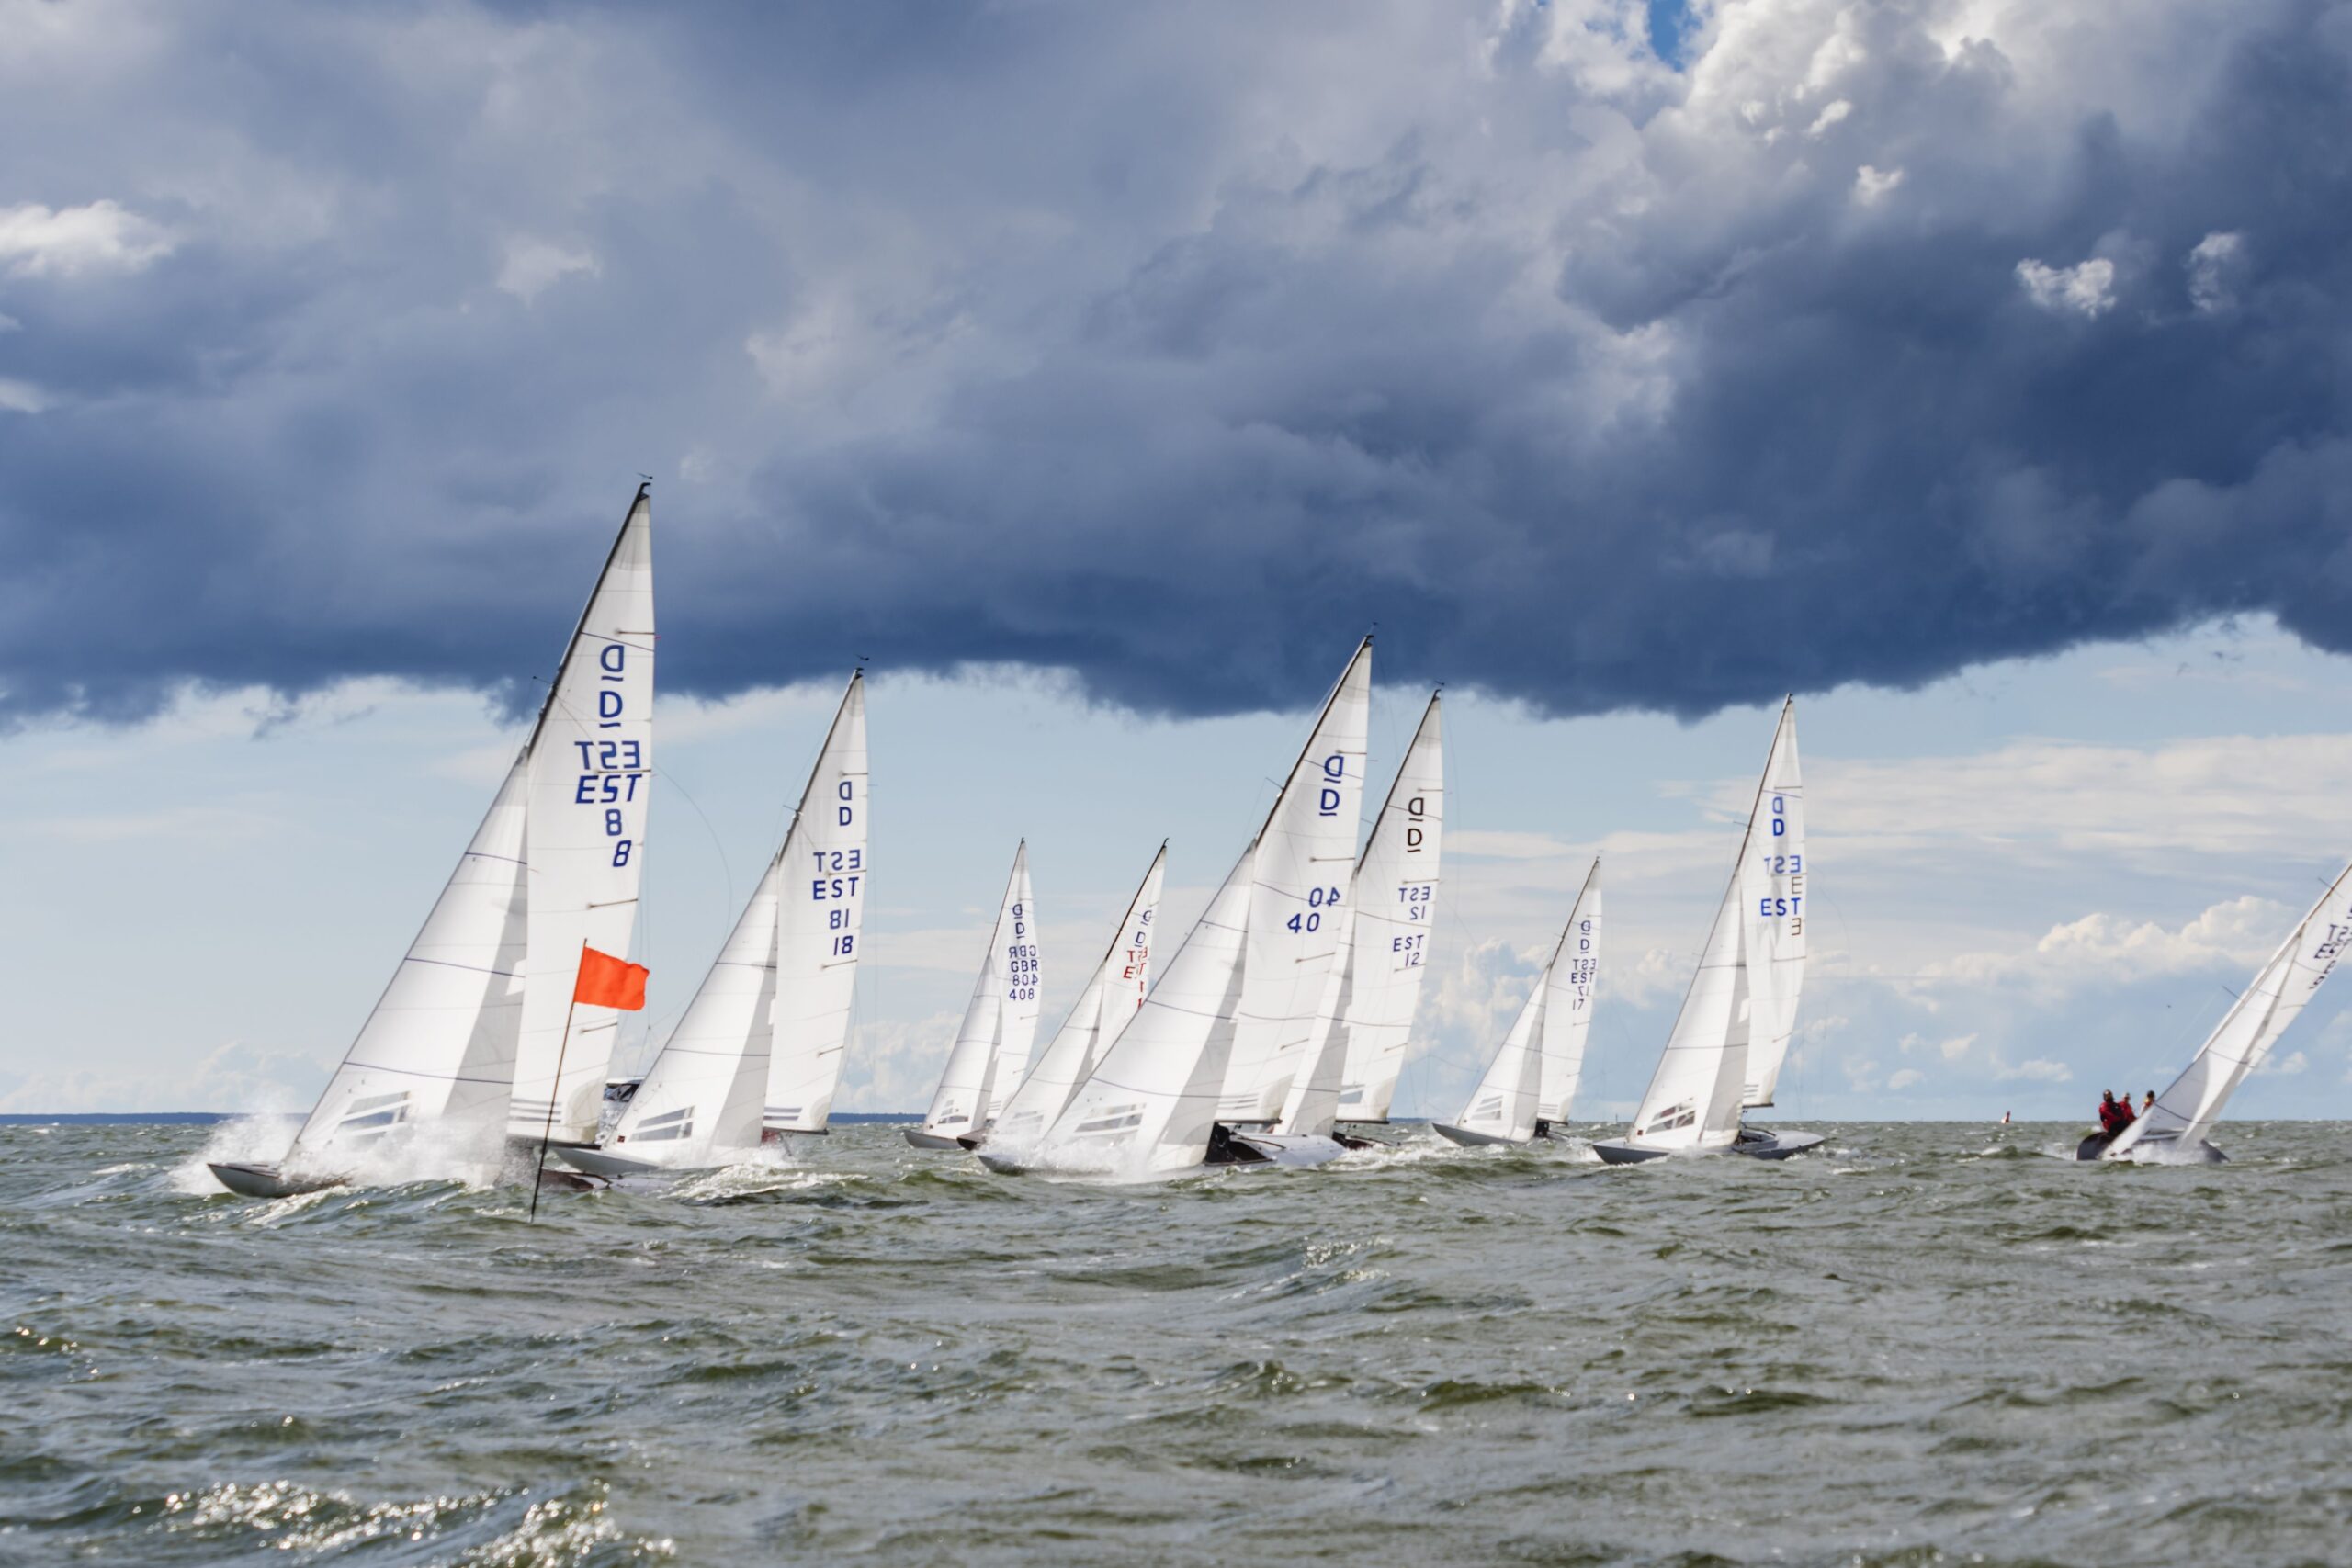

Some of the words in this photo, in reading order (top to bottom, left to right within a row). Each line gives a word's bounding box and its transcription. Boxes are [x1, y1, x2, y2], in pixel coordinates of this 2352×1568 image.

[599, 691, 623, 718] D
[575, 773, 643, 804] EST
[1321, 788, 1340, 811] D
[839, 807, 852, 826] D
[1773, 818, 1784, 836] D
[1408, 829, 1422, 847] D
[612, 840, 632, 867] 8
[812, 876, 859, 900] EST
[1761, 897, 1801, 916] EST
[1016, 922, 1025, 935] D
[1287, 912, 1320, 933] 40
[833, 935, 853, 955] 18
[1136, 931, 1146, 943] D
[1393, 935, 1424, 952] EST
[1580, 939, 1589, 950] D
[1011, 959, 1038, 973] GBR
[1406, 952, 1420, 967] 12
[1123, 963, 1146, 979] ET
[1571, 972, 1593, 984] EST
[1009, 988, 1035, 1001] 408
[1573, 999, 1584, 1010] 17
